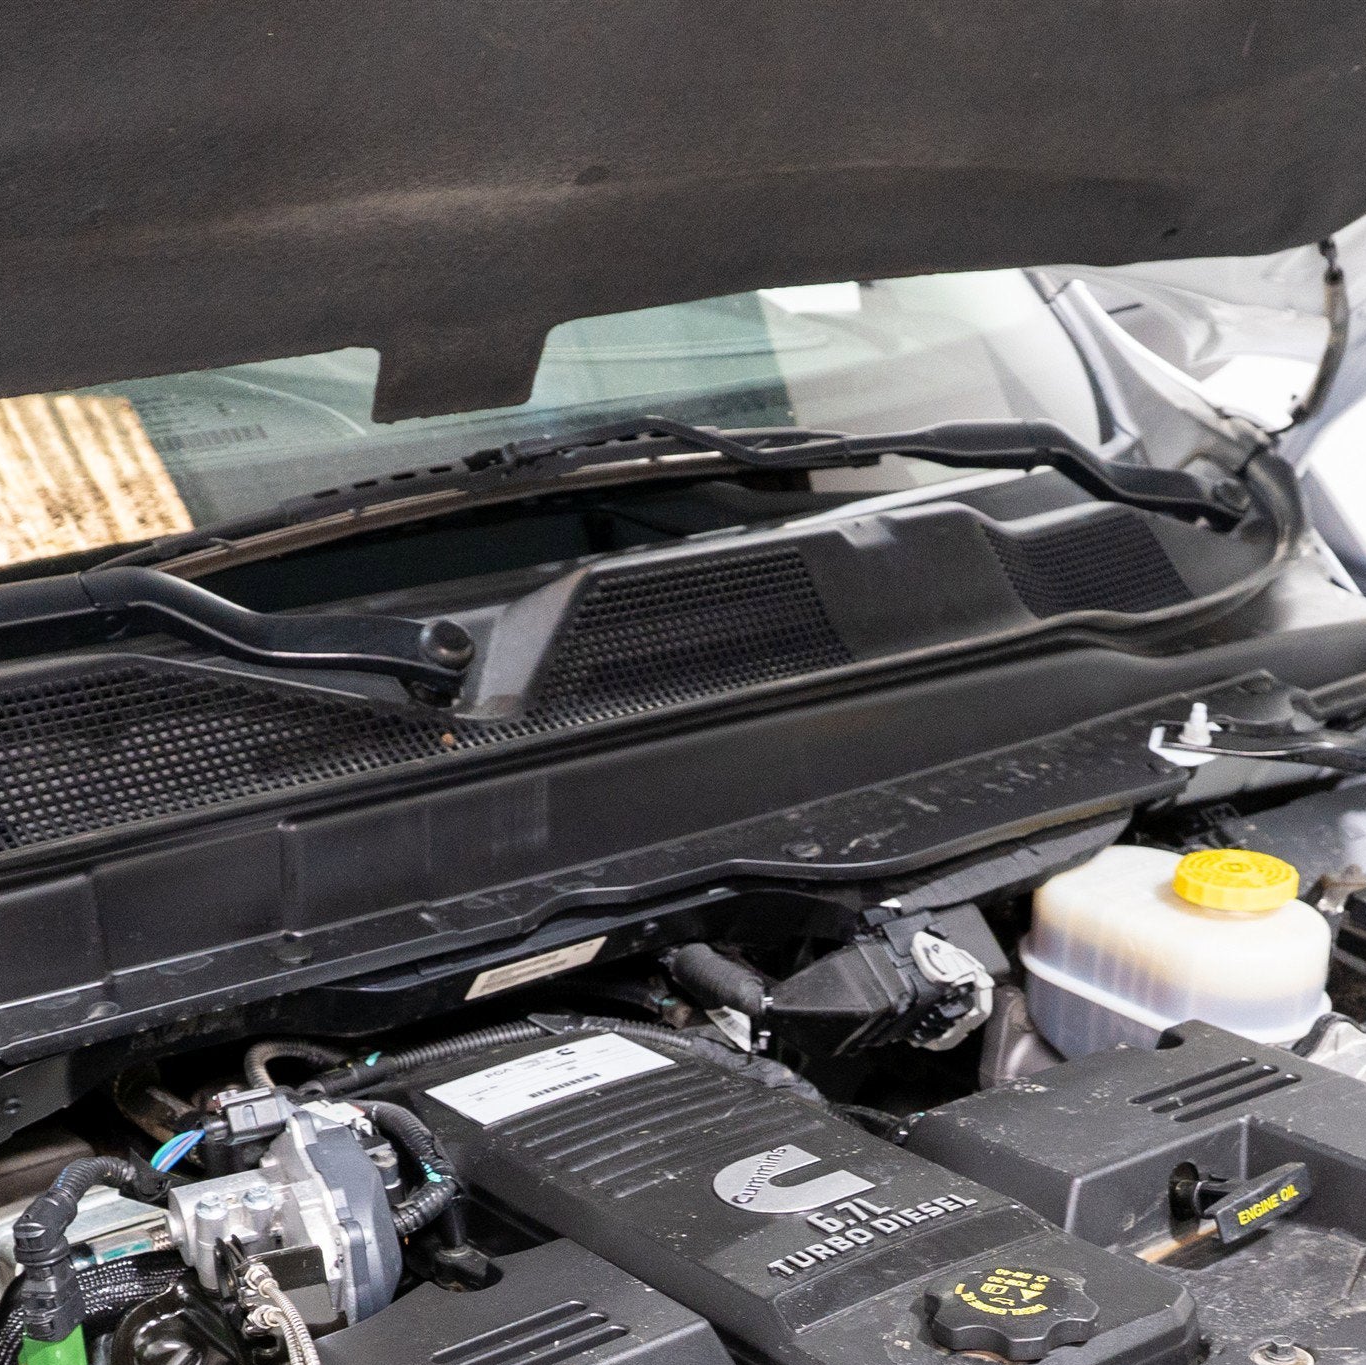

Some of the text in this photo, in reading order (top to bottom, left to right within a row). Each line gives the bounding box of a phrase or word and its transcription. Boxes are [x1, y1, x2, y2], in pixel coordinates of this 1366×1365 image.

[731, 1146, 787, 1205] Cummins
[806, 1197, 892, 1235] 6.7L
[1237, 1184, 1300, 1226] ENGINE OIL
[767, 1193, 979, 1277] TURBO DIESEL
